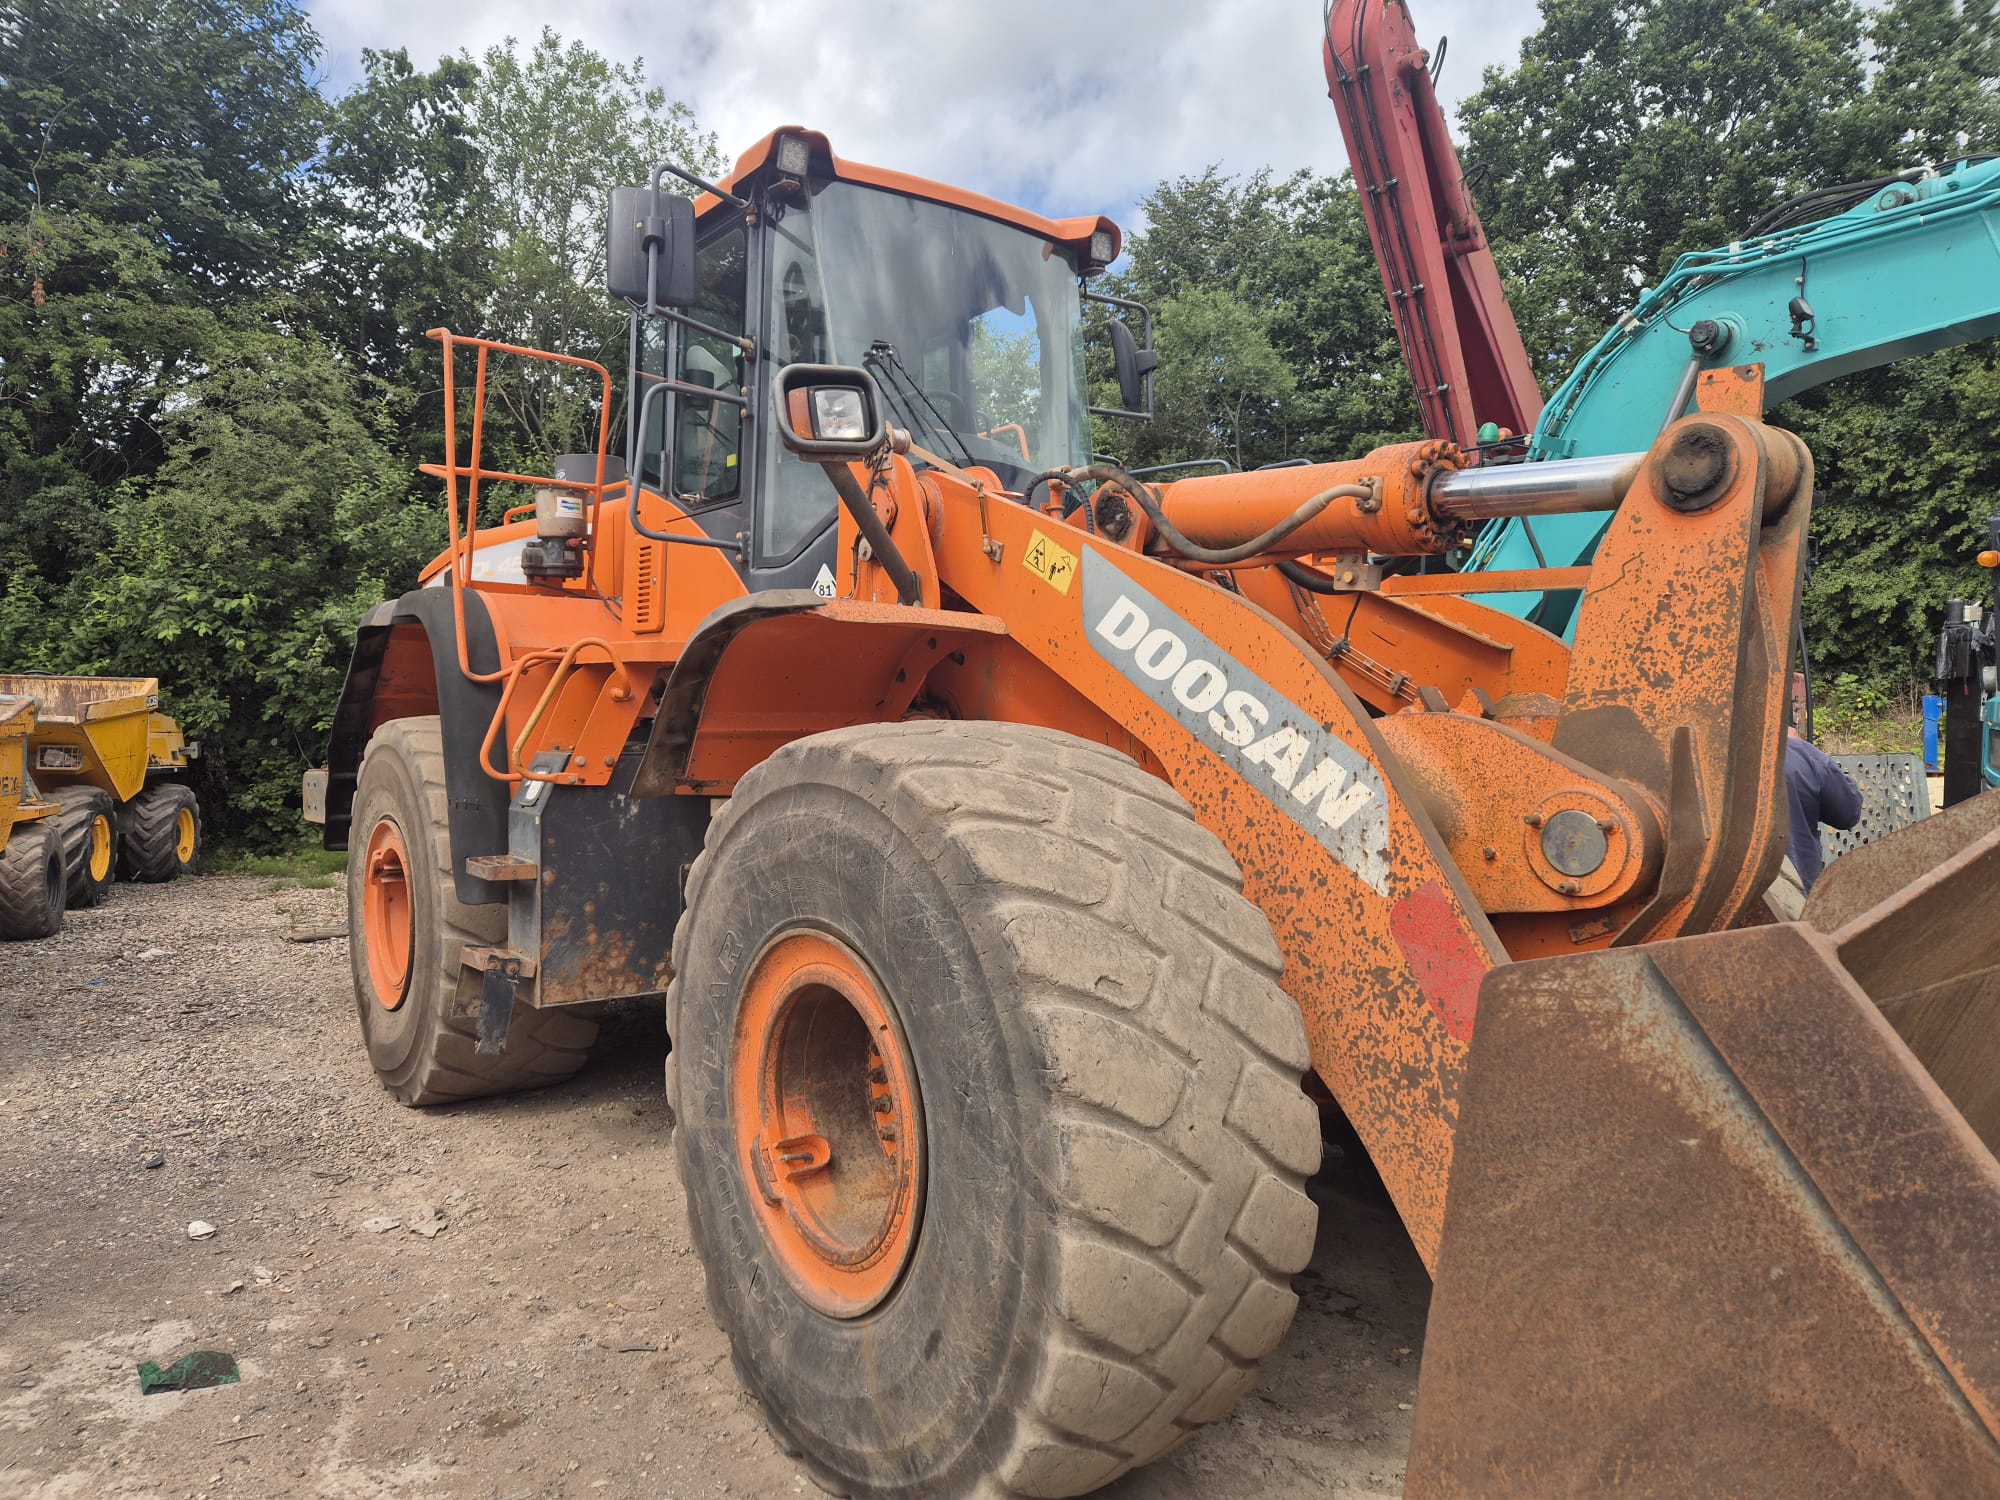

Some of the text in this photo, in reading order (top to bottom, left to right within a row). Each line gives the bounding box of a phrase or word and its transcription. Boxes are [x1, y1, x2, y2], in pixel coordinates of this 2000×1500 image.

[818, 585, 832, 596] 81
[1095, 594, 1376, 830] DOOSAN
[0, 776, 18, 796] EX
